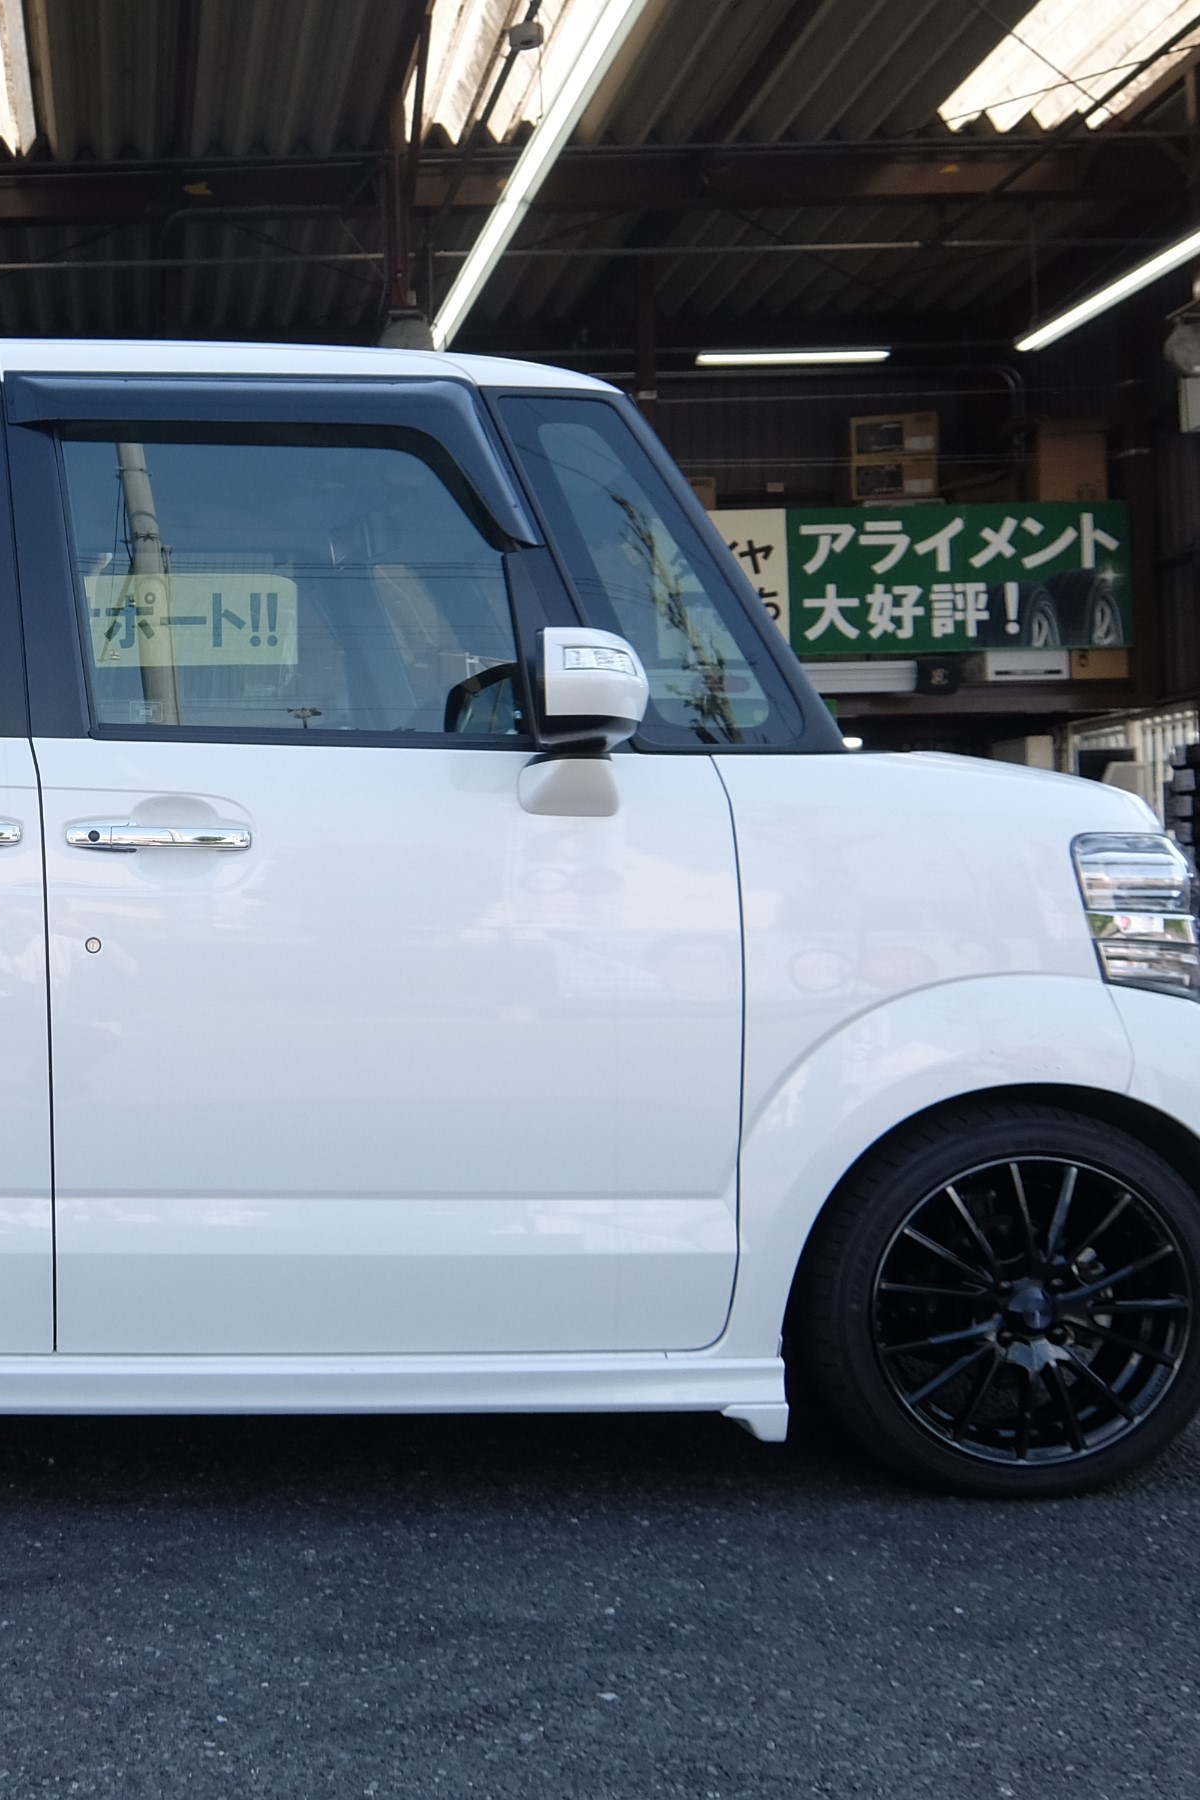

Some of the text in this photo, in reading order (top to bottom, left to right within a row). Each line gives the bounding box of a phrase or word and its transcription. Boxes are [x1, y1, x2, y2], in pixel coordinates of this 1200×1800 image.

[799, 512, 1120, 574] アライメント
[89, 591, 278, 649] ポート!!
[803, 582, 1020, 640] 大好評！
